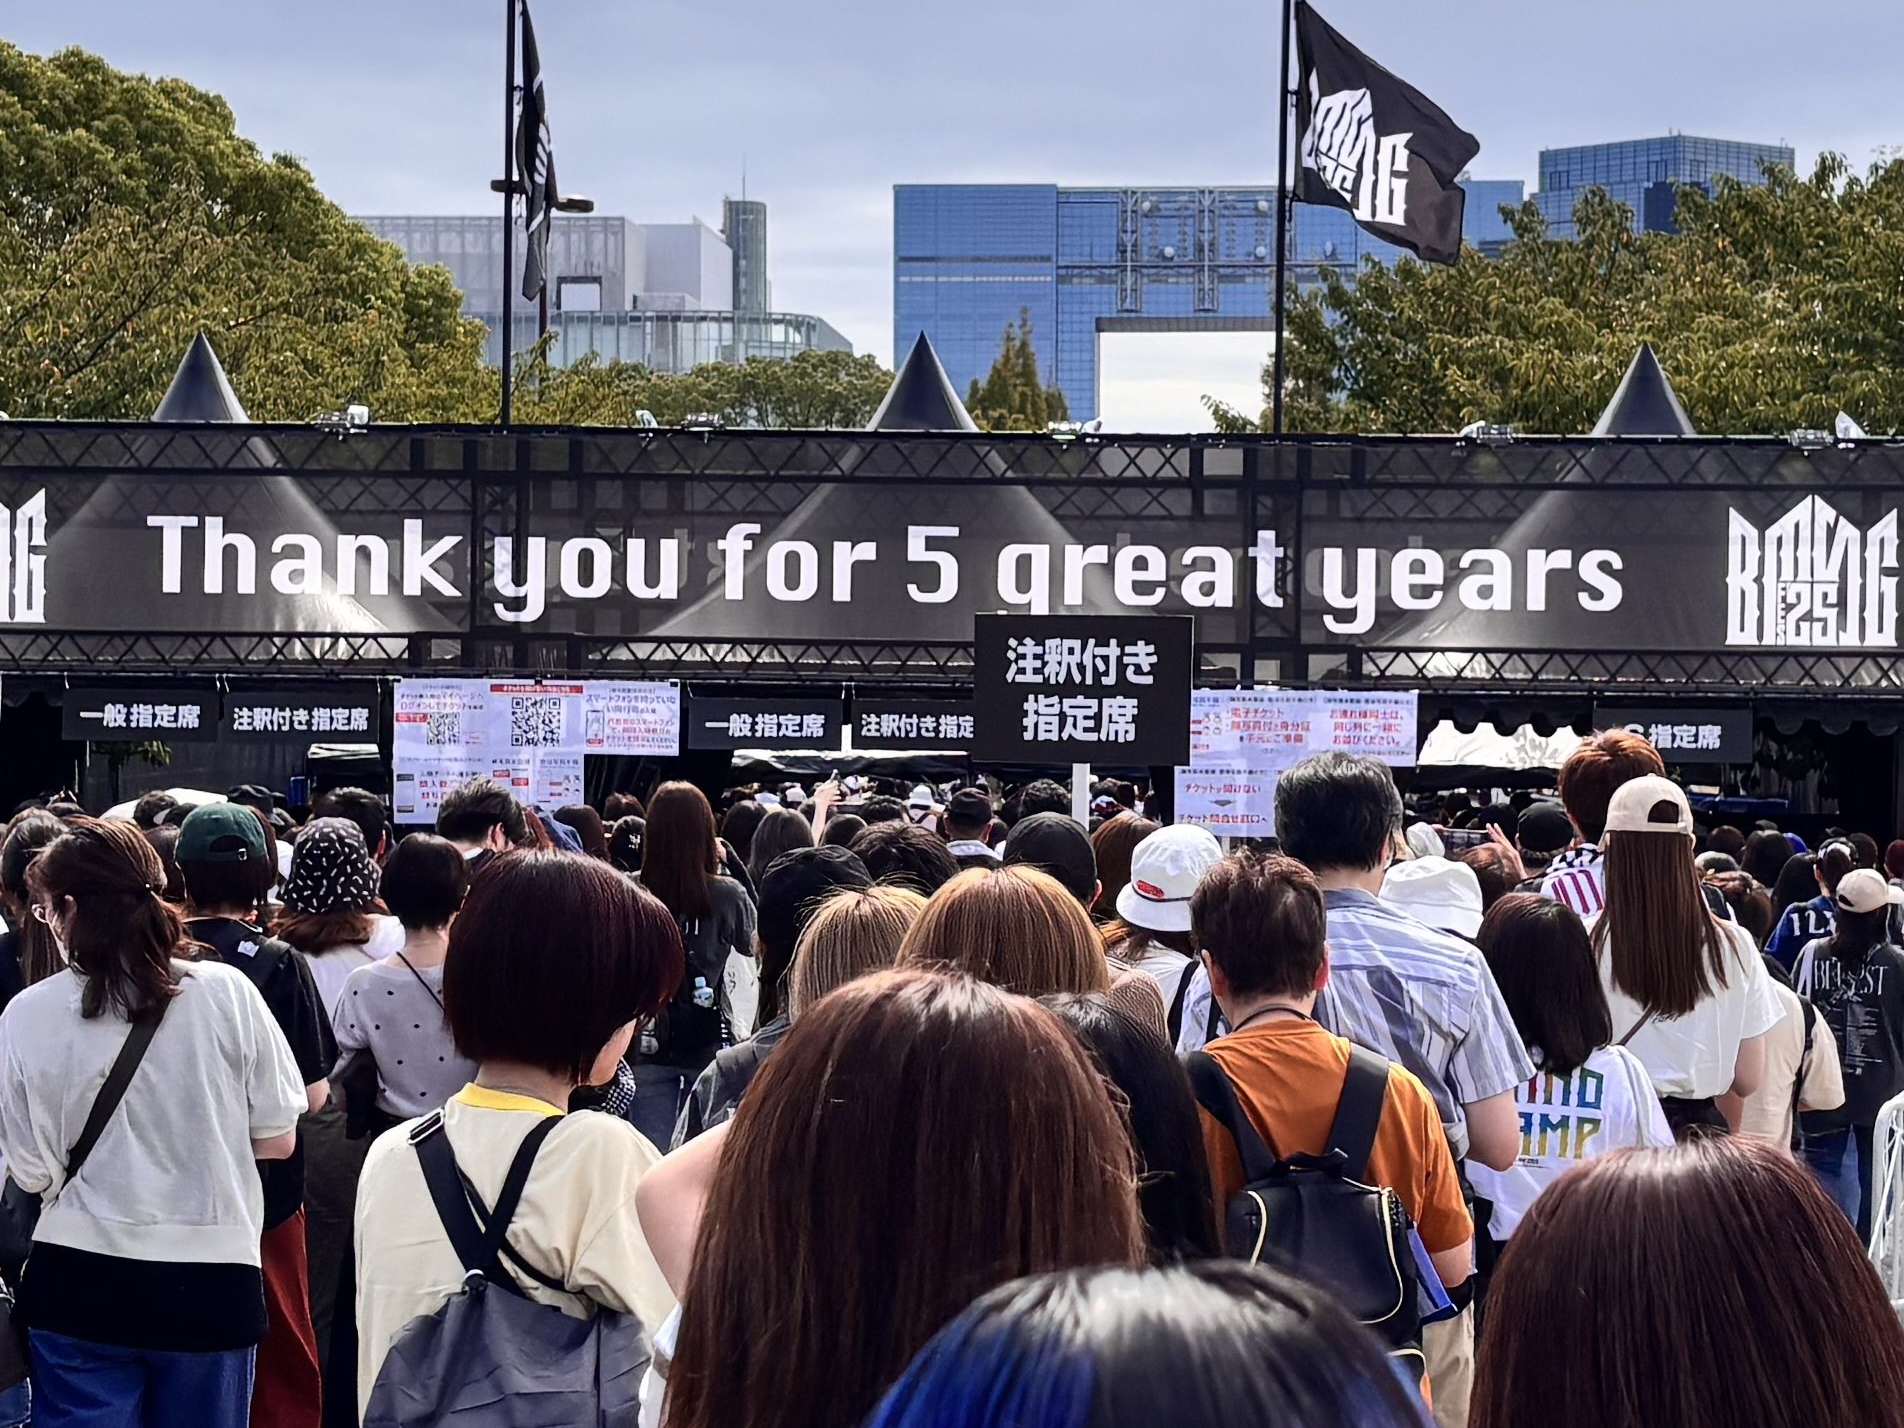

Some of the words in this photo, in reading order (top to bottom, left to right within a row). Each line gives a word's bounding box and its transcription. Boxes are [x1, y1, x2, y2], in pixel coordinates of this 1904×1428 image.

[146, 515, 463, 597] Thank
[492, 535, 680, 624] you
[717, 522, 877, 604] for
[905, 524, 961, 605] 5
[997, 529, 1284, 614] great
[1321, 545, 1625, 636] years
[1005, 637, 1158, 686] 注釈付き
[79, 703, 201, 729] 一般指定席
[233, 707, 369, 732] 注釈付き指定席
[704, 713, 826, 738] 一般指定席
[1022, 694, 1139, 743] 指定席
